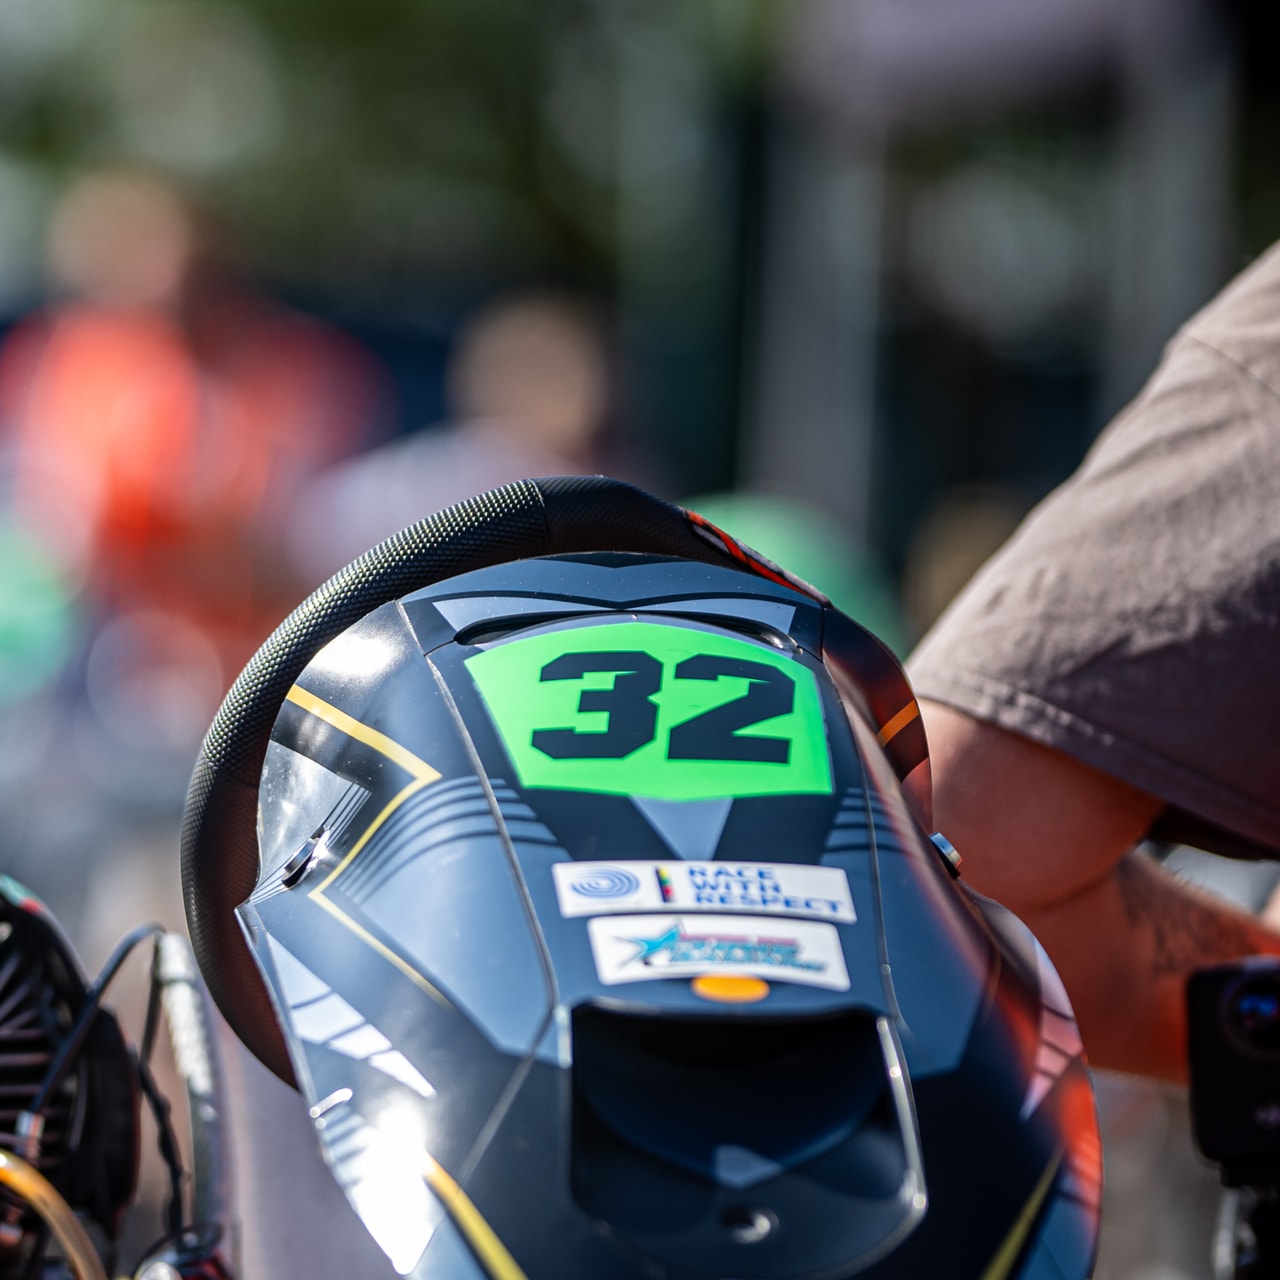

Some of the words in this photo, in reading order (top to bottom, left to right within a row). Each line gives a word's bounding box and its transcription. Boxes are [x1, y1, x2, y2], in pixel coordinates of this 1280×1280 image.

[531, 650, 797, 765] 32
[689, 865, 775, 879] RACE
[691, 879, 782, 894] WITH
[694, 893, 843, 914] RESPECT
